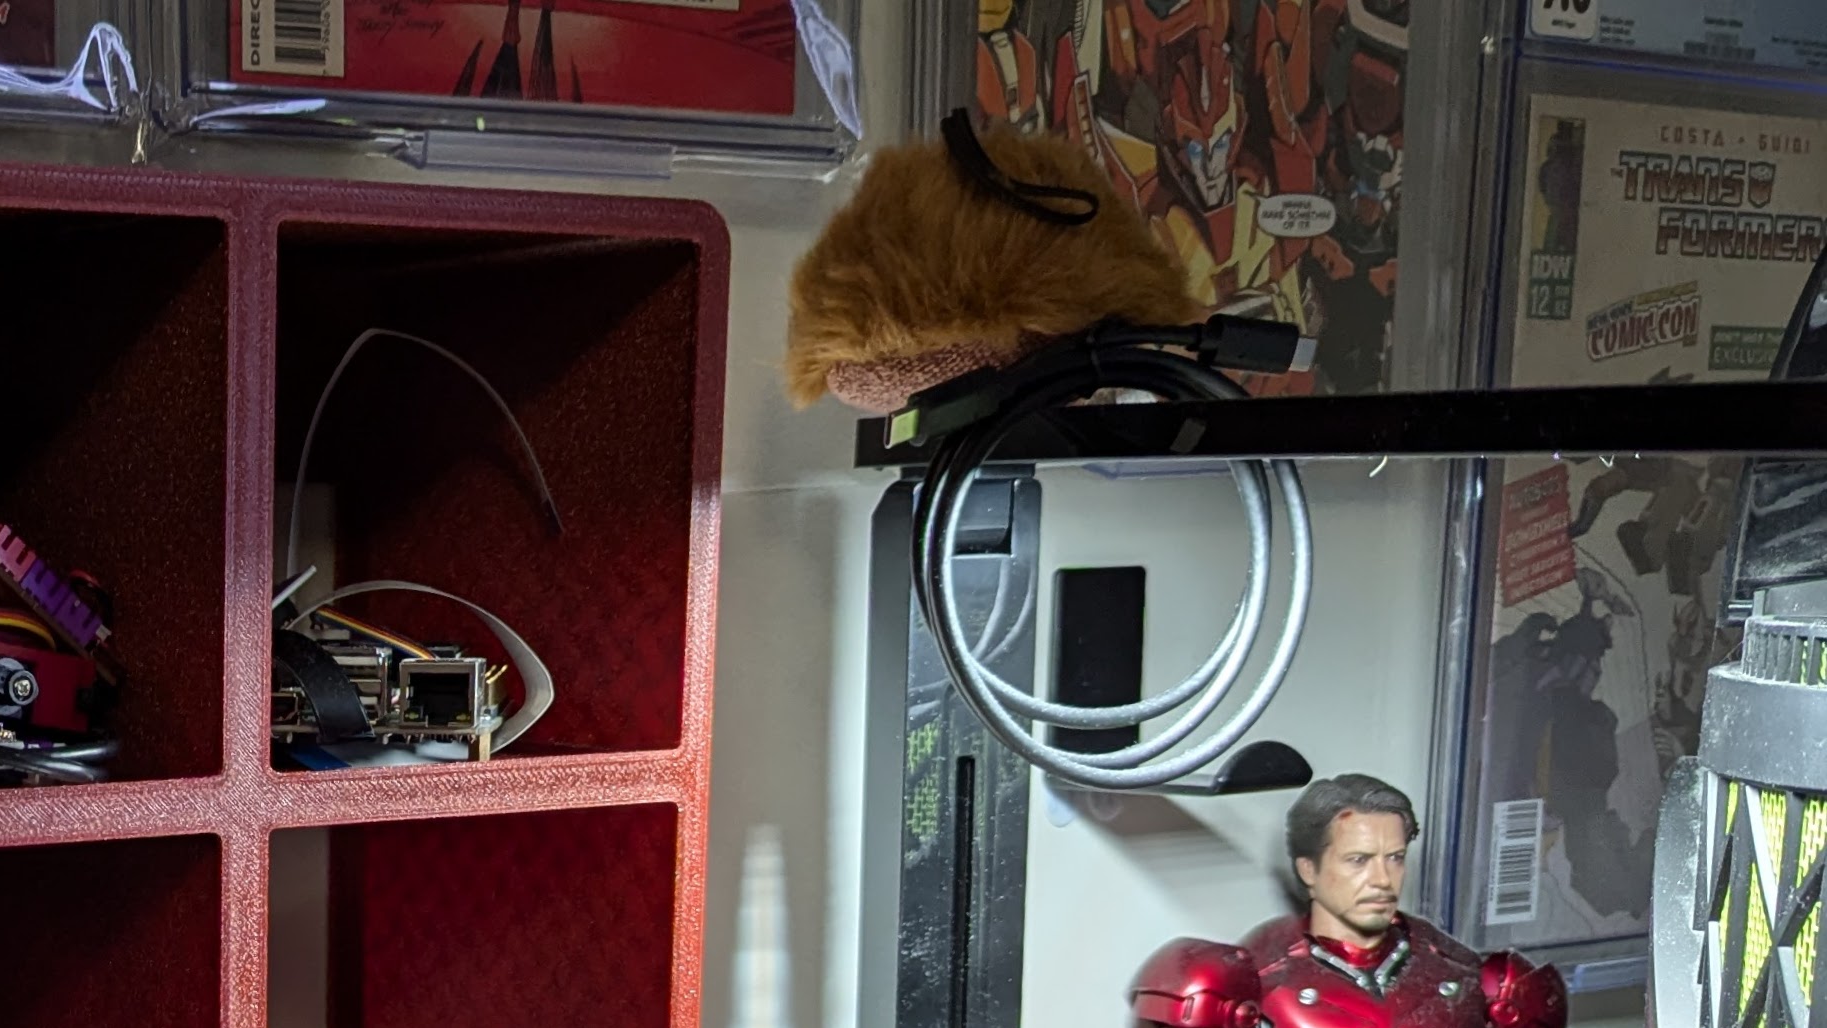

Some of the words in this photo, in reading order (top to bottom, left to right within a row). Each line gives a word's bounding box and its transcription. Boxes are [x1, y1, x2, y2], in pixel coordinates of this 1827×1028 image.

[1660, 126, 1725, 148] COSTA
[1619, 150, 1745, 207] TRANS
[1655, 206, 1827, 262] FORMER
[1531, 254, 1574, 279] IDW
[1531, 285, 1550, 316] 12
[1713, 346, 1779, 364] EXCLUSIV
